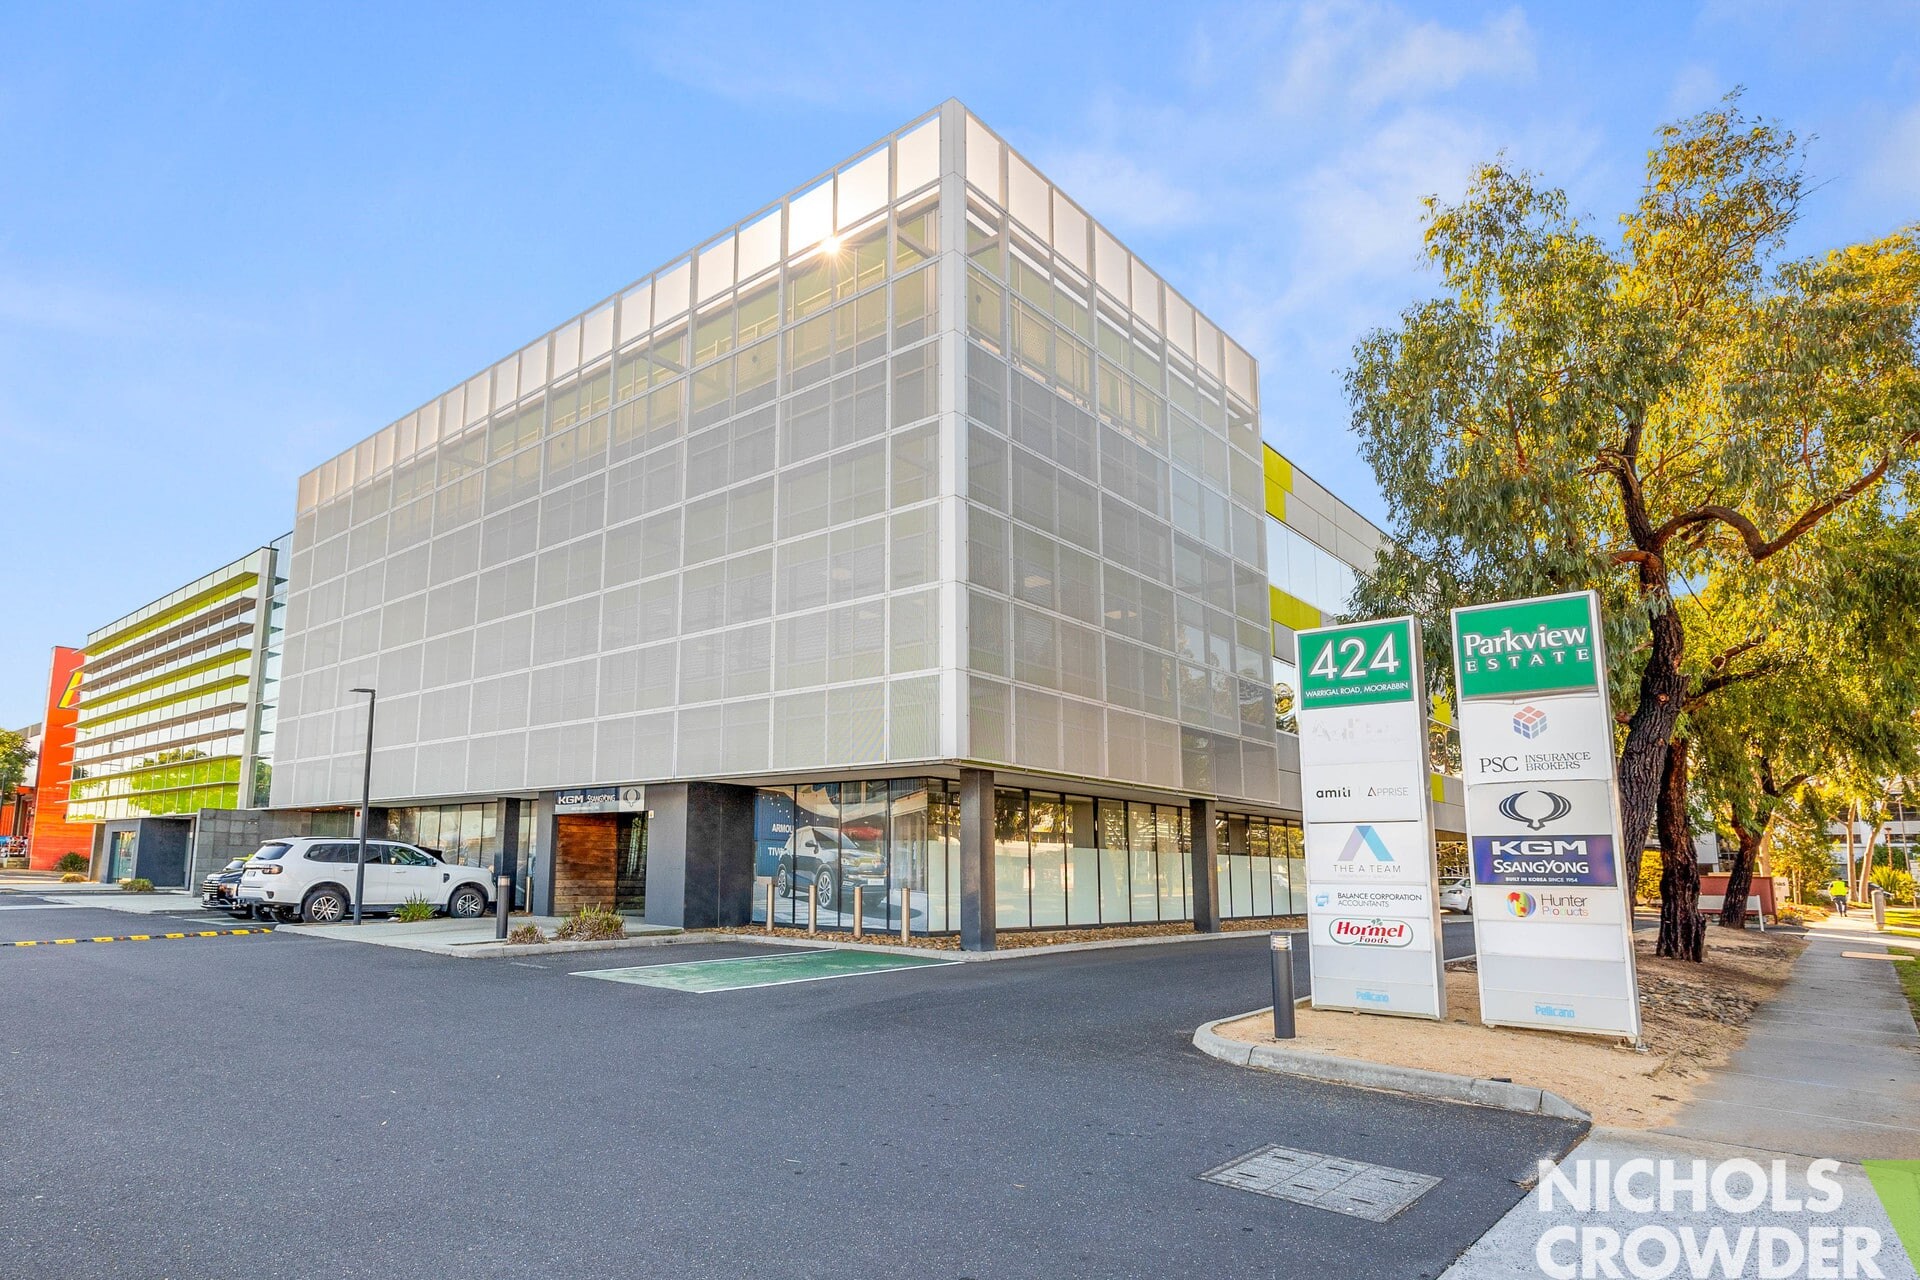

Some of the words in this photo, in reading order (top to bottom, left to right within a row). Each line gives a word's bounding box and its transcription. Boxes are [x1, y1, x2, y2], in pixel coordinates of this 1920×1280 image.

[1463, 626, 1586, 657] Parkview
[1309, 632, 1400, 679] 424
[1466, 649, 1590, 672] ESTATE
[1305, 687, 1339, 697] WARRIGAL
[1340, 686, 1362, 695] ROAD,
[1364, 682, 1409, 692] MOORABBIN
[1525, 751, 1591, 763] INSURANCE
[1480, 756, 1519, 773] PSC
[1526, 761, 1581, 771] BROKERS
[1367, 787, 1409, 797] APPRISE
[558, 794, 584, 804] KGM
[1491, 840, 1588, 855] KGM
[1333, 865, 1354, 873] THE
[1370, 865, 1401, 873] TEAM
[1337, 892, 1368, 900] BALANCE
[1370, 893, 1422, 901] CORPORATION
[1540, 893, 1588, 907] Hunter
[1336, 921, 1404, 938] Hormel
[1359, 936, 1389, 944] Foods
[1535, 1005, 1576, 1018] Pellicano
